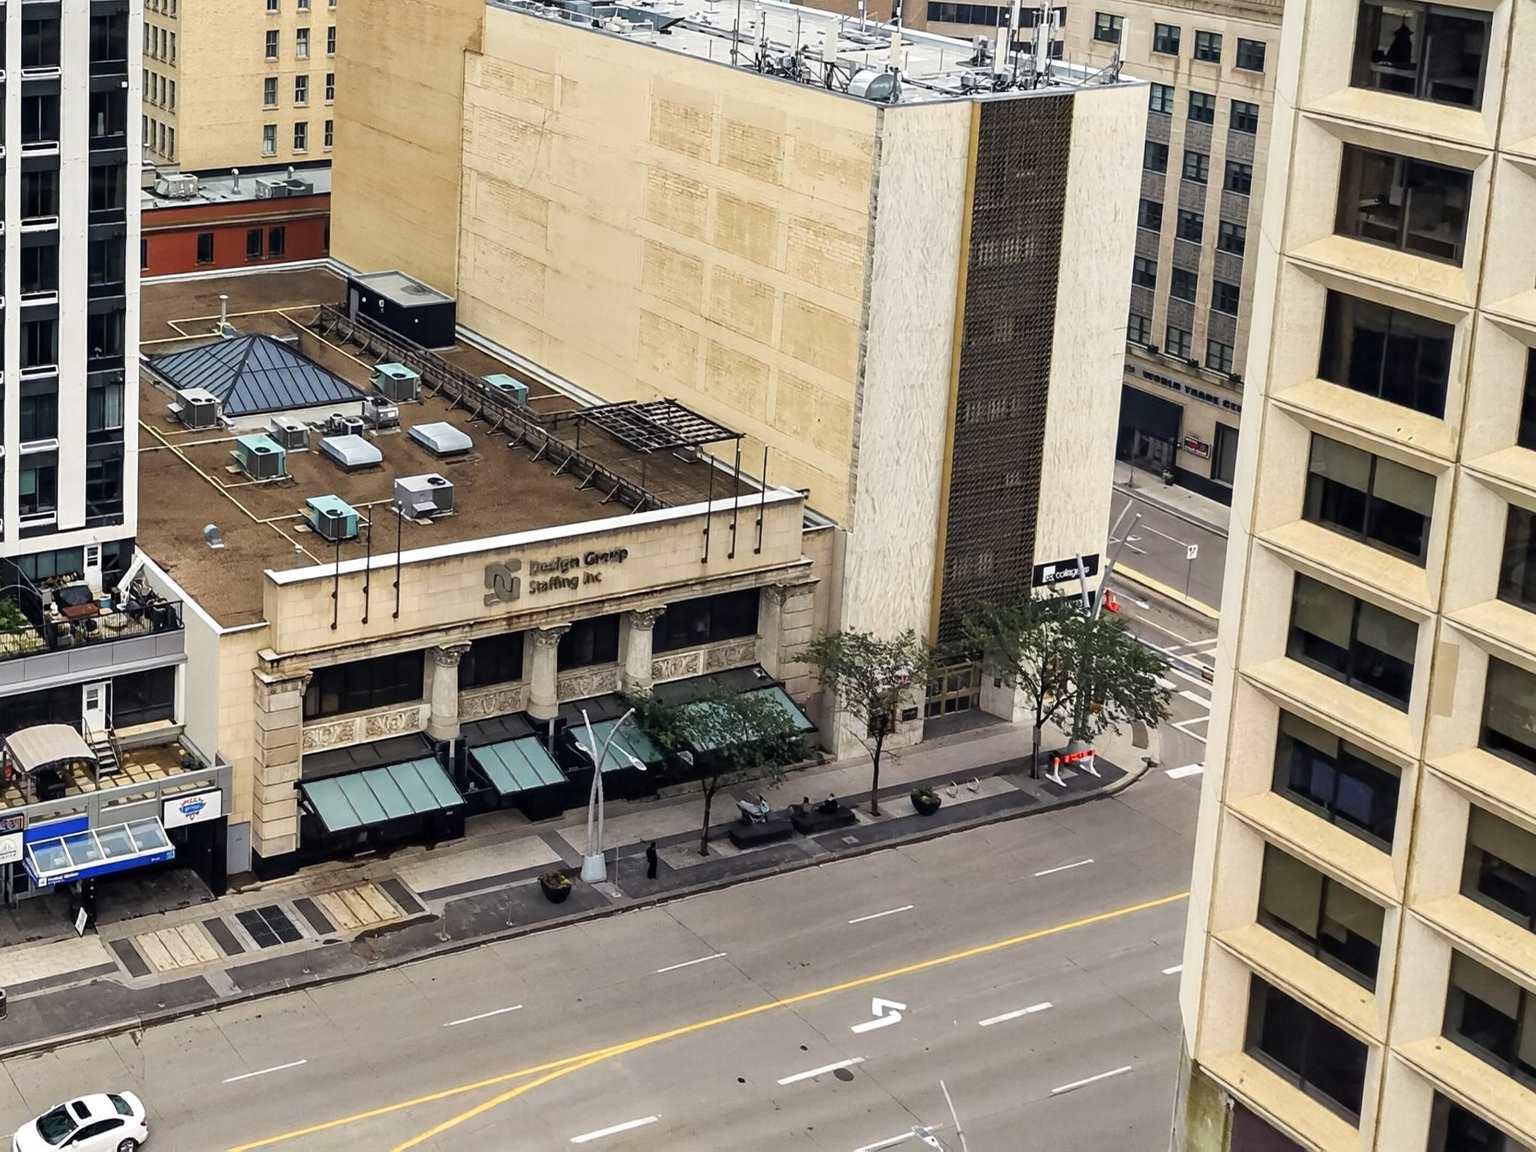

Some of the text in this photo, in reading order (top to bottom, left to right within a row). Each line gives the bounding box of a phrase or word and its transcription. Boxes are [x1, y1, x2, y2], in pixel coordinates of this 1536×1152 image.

[529, 548, 629, 576] Design Group
[529, 575, 580, 595] Staffing
